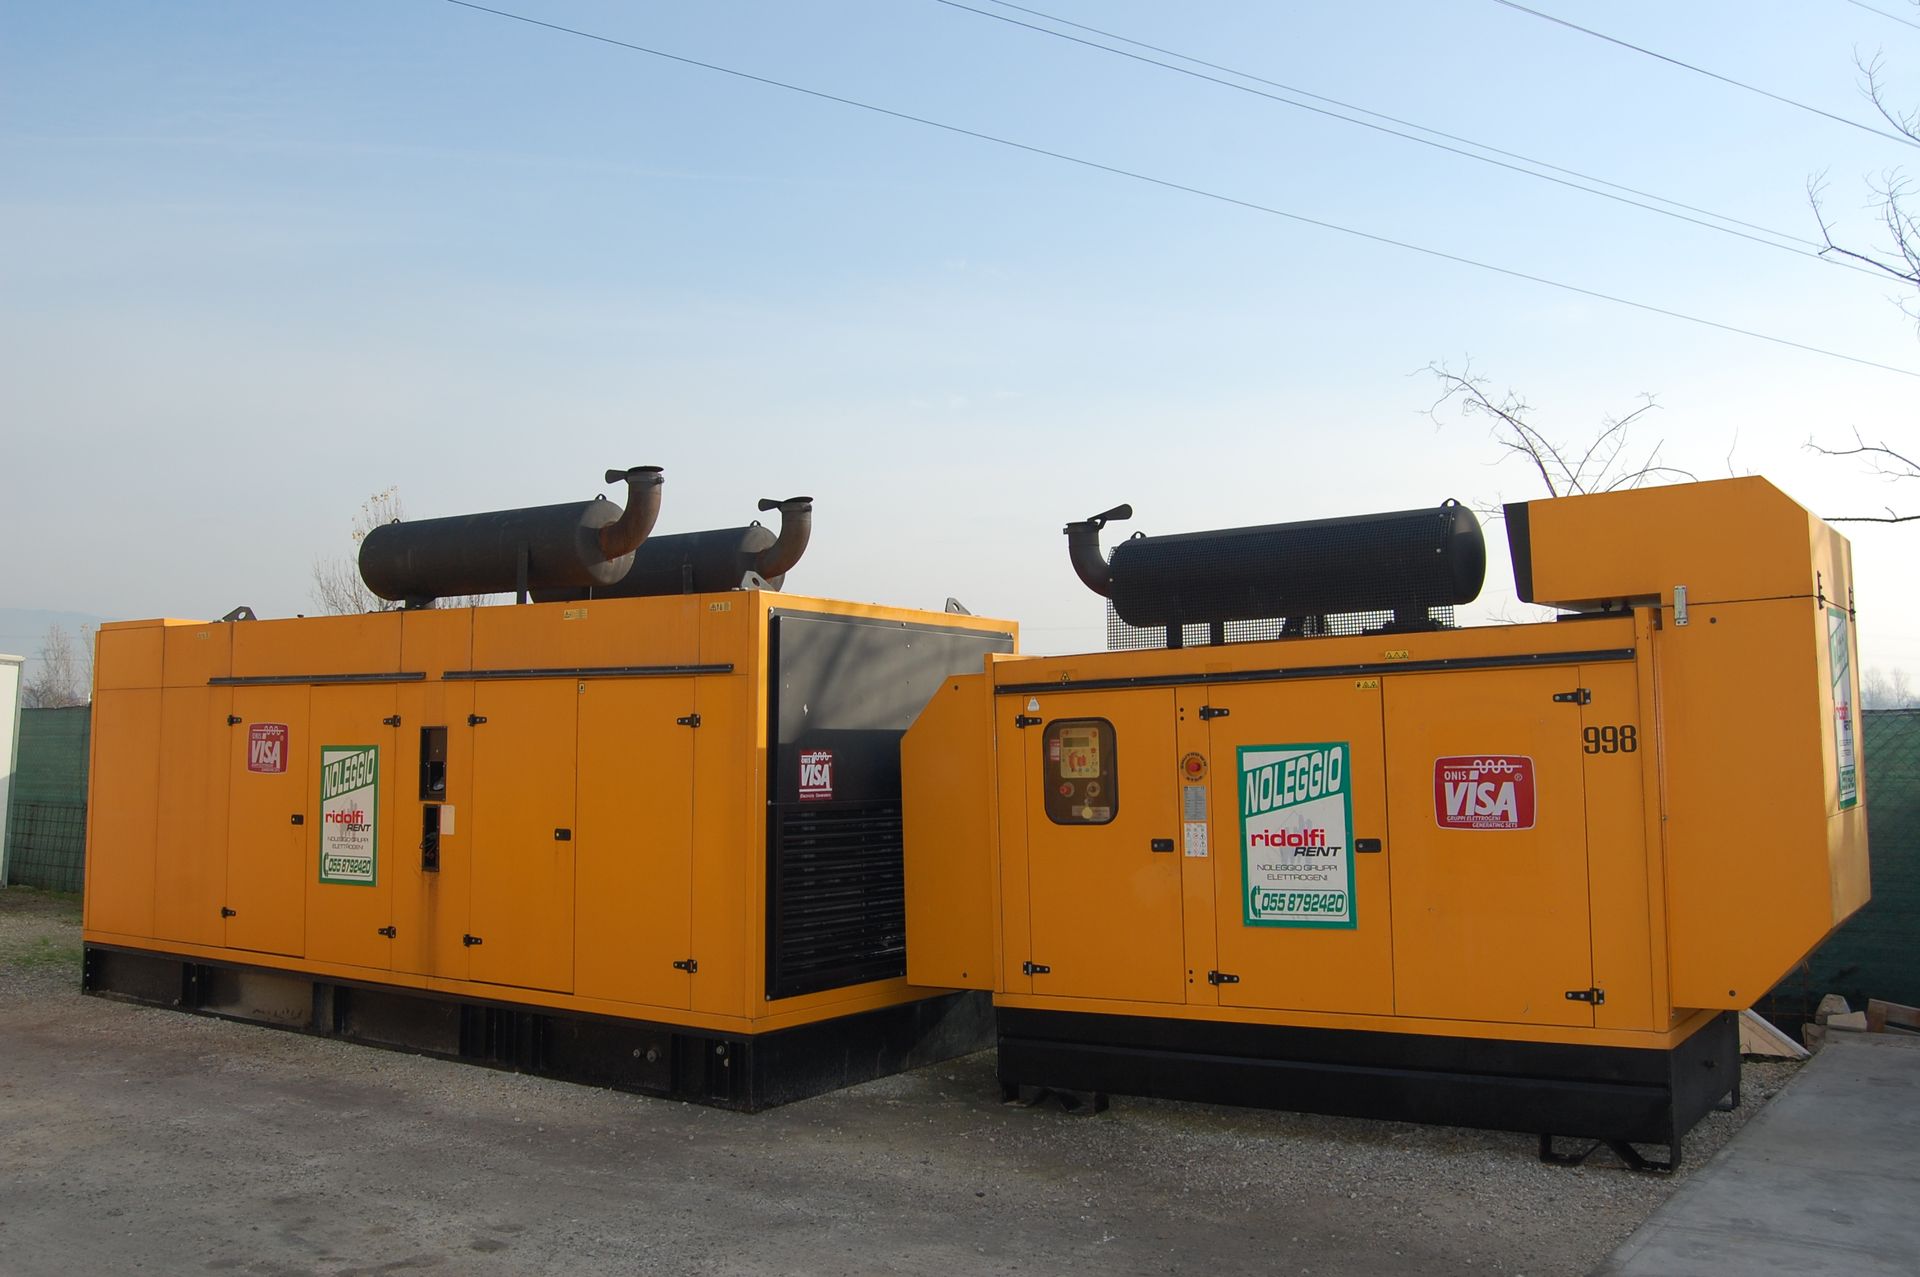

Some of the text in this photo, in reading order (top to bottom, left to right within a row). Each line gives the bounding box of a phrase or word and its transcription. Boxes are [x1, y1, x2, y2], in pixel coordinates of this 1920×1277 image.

[1583, 724, 1637, 755] 998
[251, 733, 281, 769] VISA
[323, 749, 375, 799] NOLEGGIO
[801, 758, 831, 789] VISA
[1245, 746, 1343, 816] NOLEGGIO
[1444, 770, 1467, 781] ONIS
[1444, 771, 1519, 822] VISA
[325, 809, 364, 824] ridolfi
[346, 823, 371, 832] RENT
[1251, 829, 1325, 847] ridolfi
[1294, 846, 1342, 857] RENT
[328, 858, 371, 874] 055 8792420
[1256, 864, 1338, 872] NOLEGGIO GRUPPI
[1266, 873, 1328, 882] ELETTROGENI
[1261, 892, 1344, 913] 055 8792420
